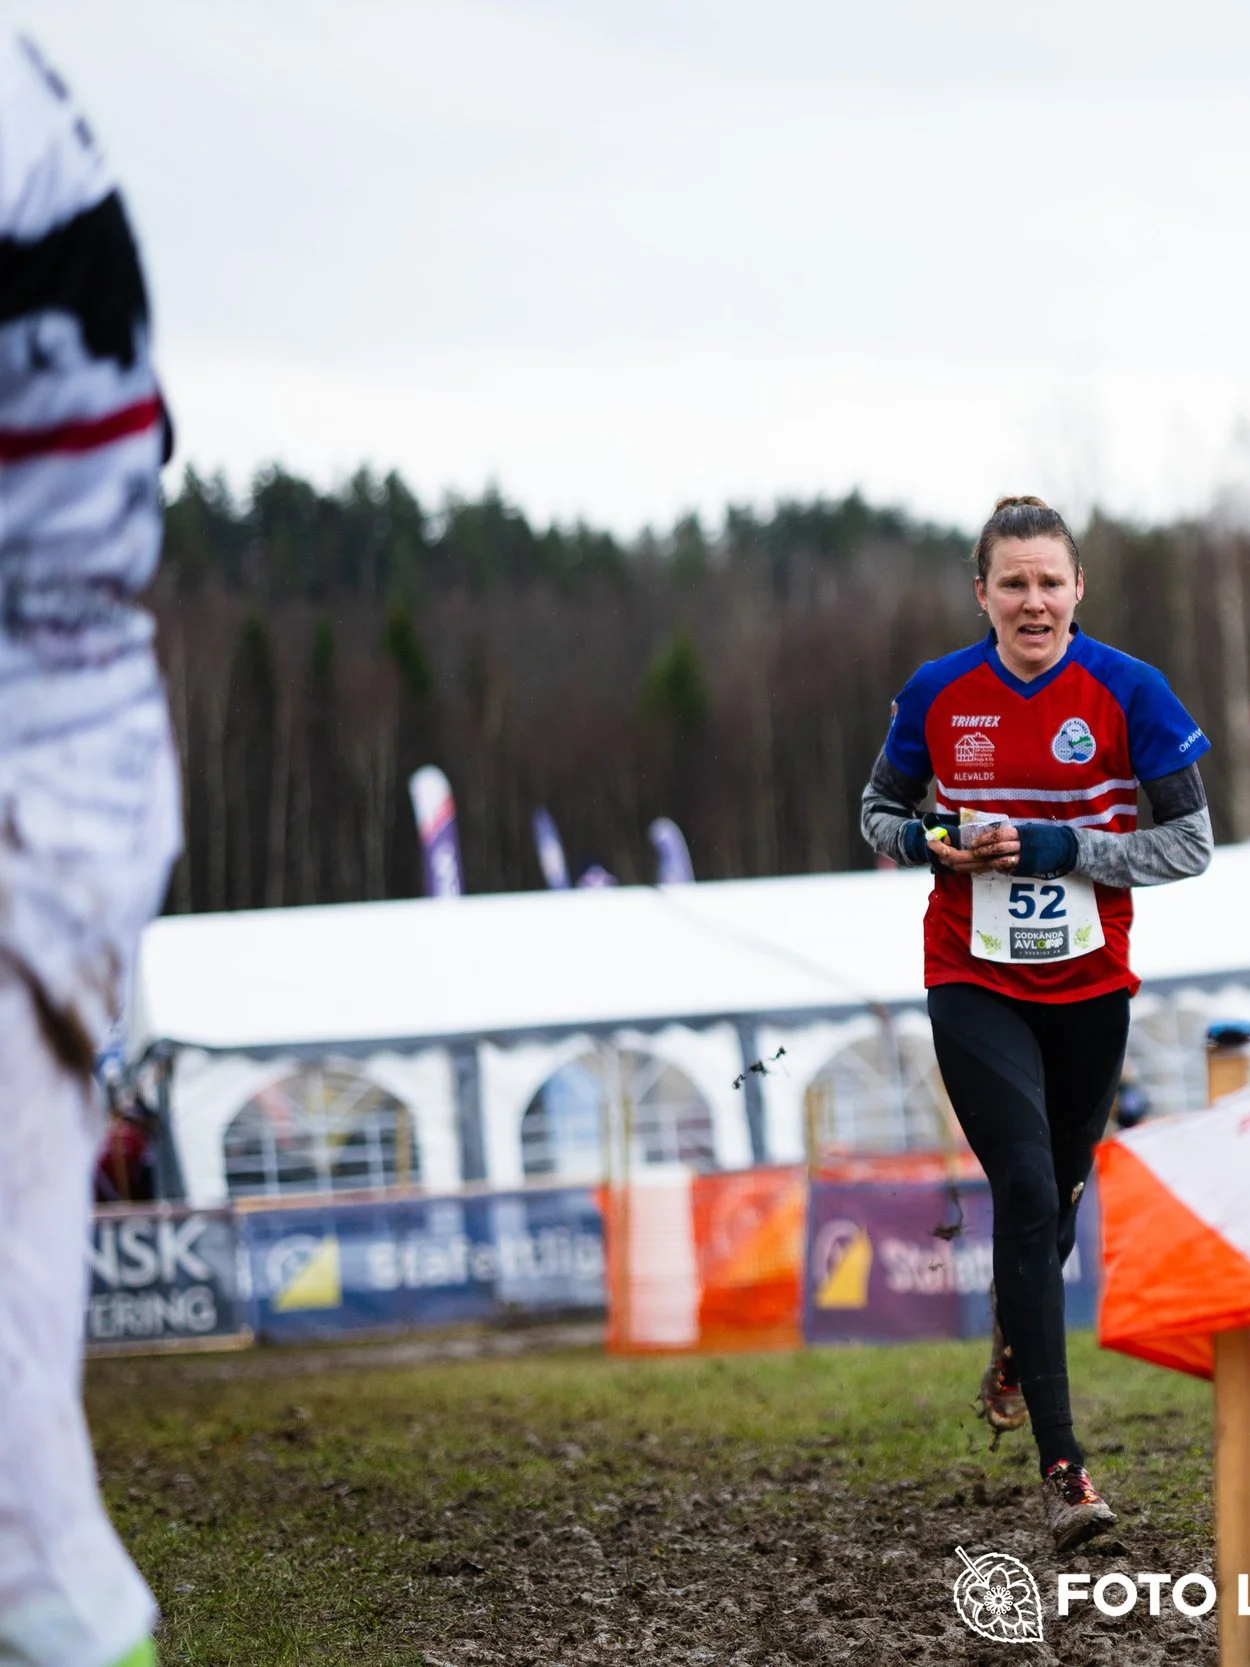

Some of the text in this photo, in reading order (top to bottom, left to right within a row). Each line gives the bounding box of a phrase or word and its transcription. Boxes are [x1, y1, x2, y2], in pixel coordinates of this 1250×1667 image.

[952, 715, 1001, 727] TRIMTEX
[954, 772, 995, 781] ALEWALDS
[1008, 883, 1067, 919] 52
[1014, 931, 1065, 940] GODKÄNDA
